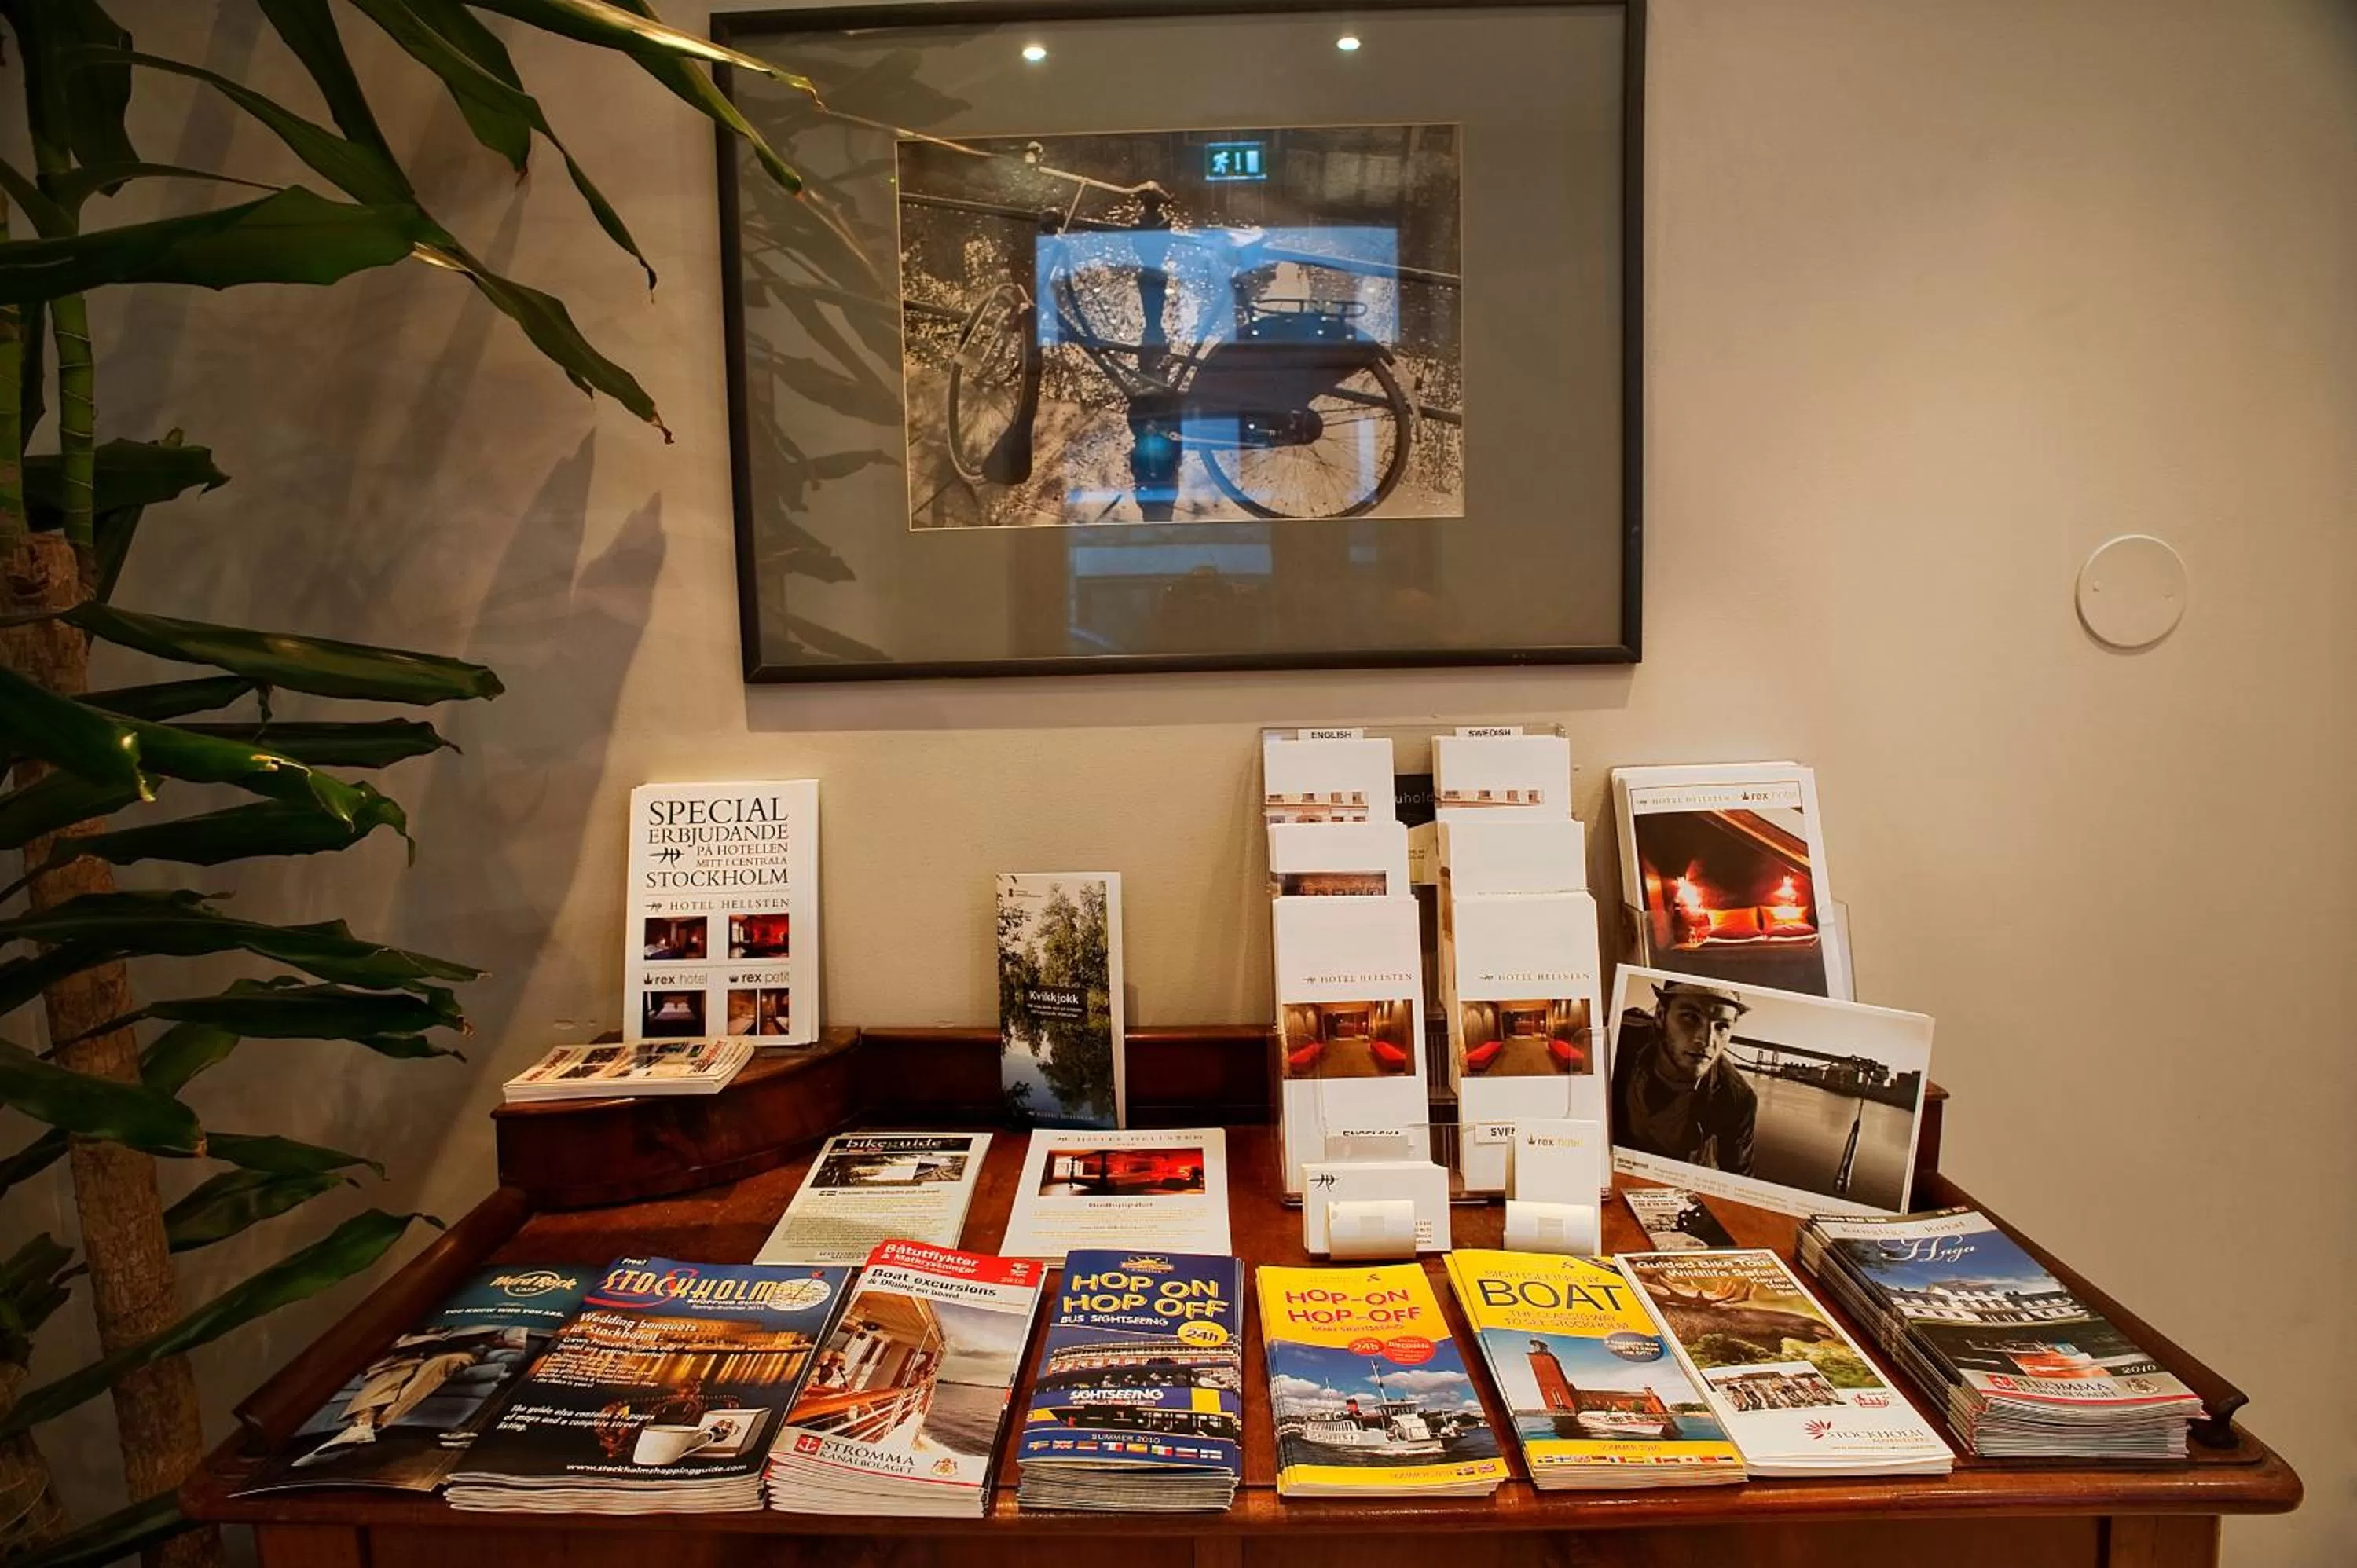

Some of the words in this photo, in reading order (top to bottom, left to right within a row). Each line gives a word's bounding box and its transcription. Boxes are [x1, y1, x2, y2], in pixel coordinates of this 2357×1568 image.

[649, 797, 788, 826] SPECIAL
[648, 825, 788, 847] ERBJUDANDE
[697, 844, 713, 856] PÅ
[717, 843, 788, 855] HOTELLEN
[647, 868, 788, 888] STOCKHOLM
[670, 901, 713, 910] HOTEL
[721, 899, 789, 909] HELLSTEN
[654, 974, 675, 985] rex
[742, 972, 761, 983] rex
[1029, 990, 1078, 1005] Kvikkjokk
[1636, 1260, 1695, 1269] Guided
[1699, 1259, 1736, 1269] Bike
[1736, 1258, 1774, 1268] Tour
[490, 1275, 535, 1287] Hard
[534, 1276, 577, 1290] Rock
[603, 1269, 781, 1301] STOCKHOLM
[872, 1269, 910, 1283] Boat
[914, 1277, 997, 1296] excursions
[880, 1279, 914, 1292] Dining
[931, 1288, 959, 1299] board
[1071, 1272, 1153, 1292] HOP
[1160, 1279, 1219, 1299] ON
[1285, 1289, 1409, 1306] HOP-ON
[1477, 1279, 1622, 1310] BOAT
[1062, 1293, 1148, 1314] HOP
[1153, 1298, 1230, 1320] OFF
[580, 1313, 636, 1328] Wedding
[638, 1319, 697, 1332] banquets
[1061, 1314, 1084, 1324] BUS
[1090, 1315, 1168, 1326] SIGHTSEEING
[1288, 1306, 1421, 1324] HOP-OFF
[1186, 1329, 1219, 1343] 24h
[2122, 1365, 2156, 1374] 2010
[1069, 1388, 1164, 1401] SIGHTSEEING
[526, 1406, 553, 1415] guide
[497, 1422, 527, 1432] listing.
[569, 1419, 609, 1427] complete
[1137, 1435, 1160, 1444] 2010
[566, 1464, 747, 1475] www.stockholmshoppingguide.com
[819, 1451, 915, 1473] KANALBOLAGET
